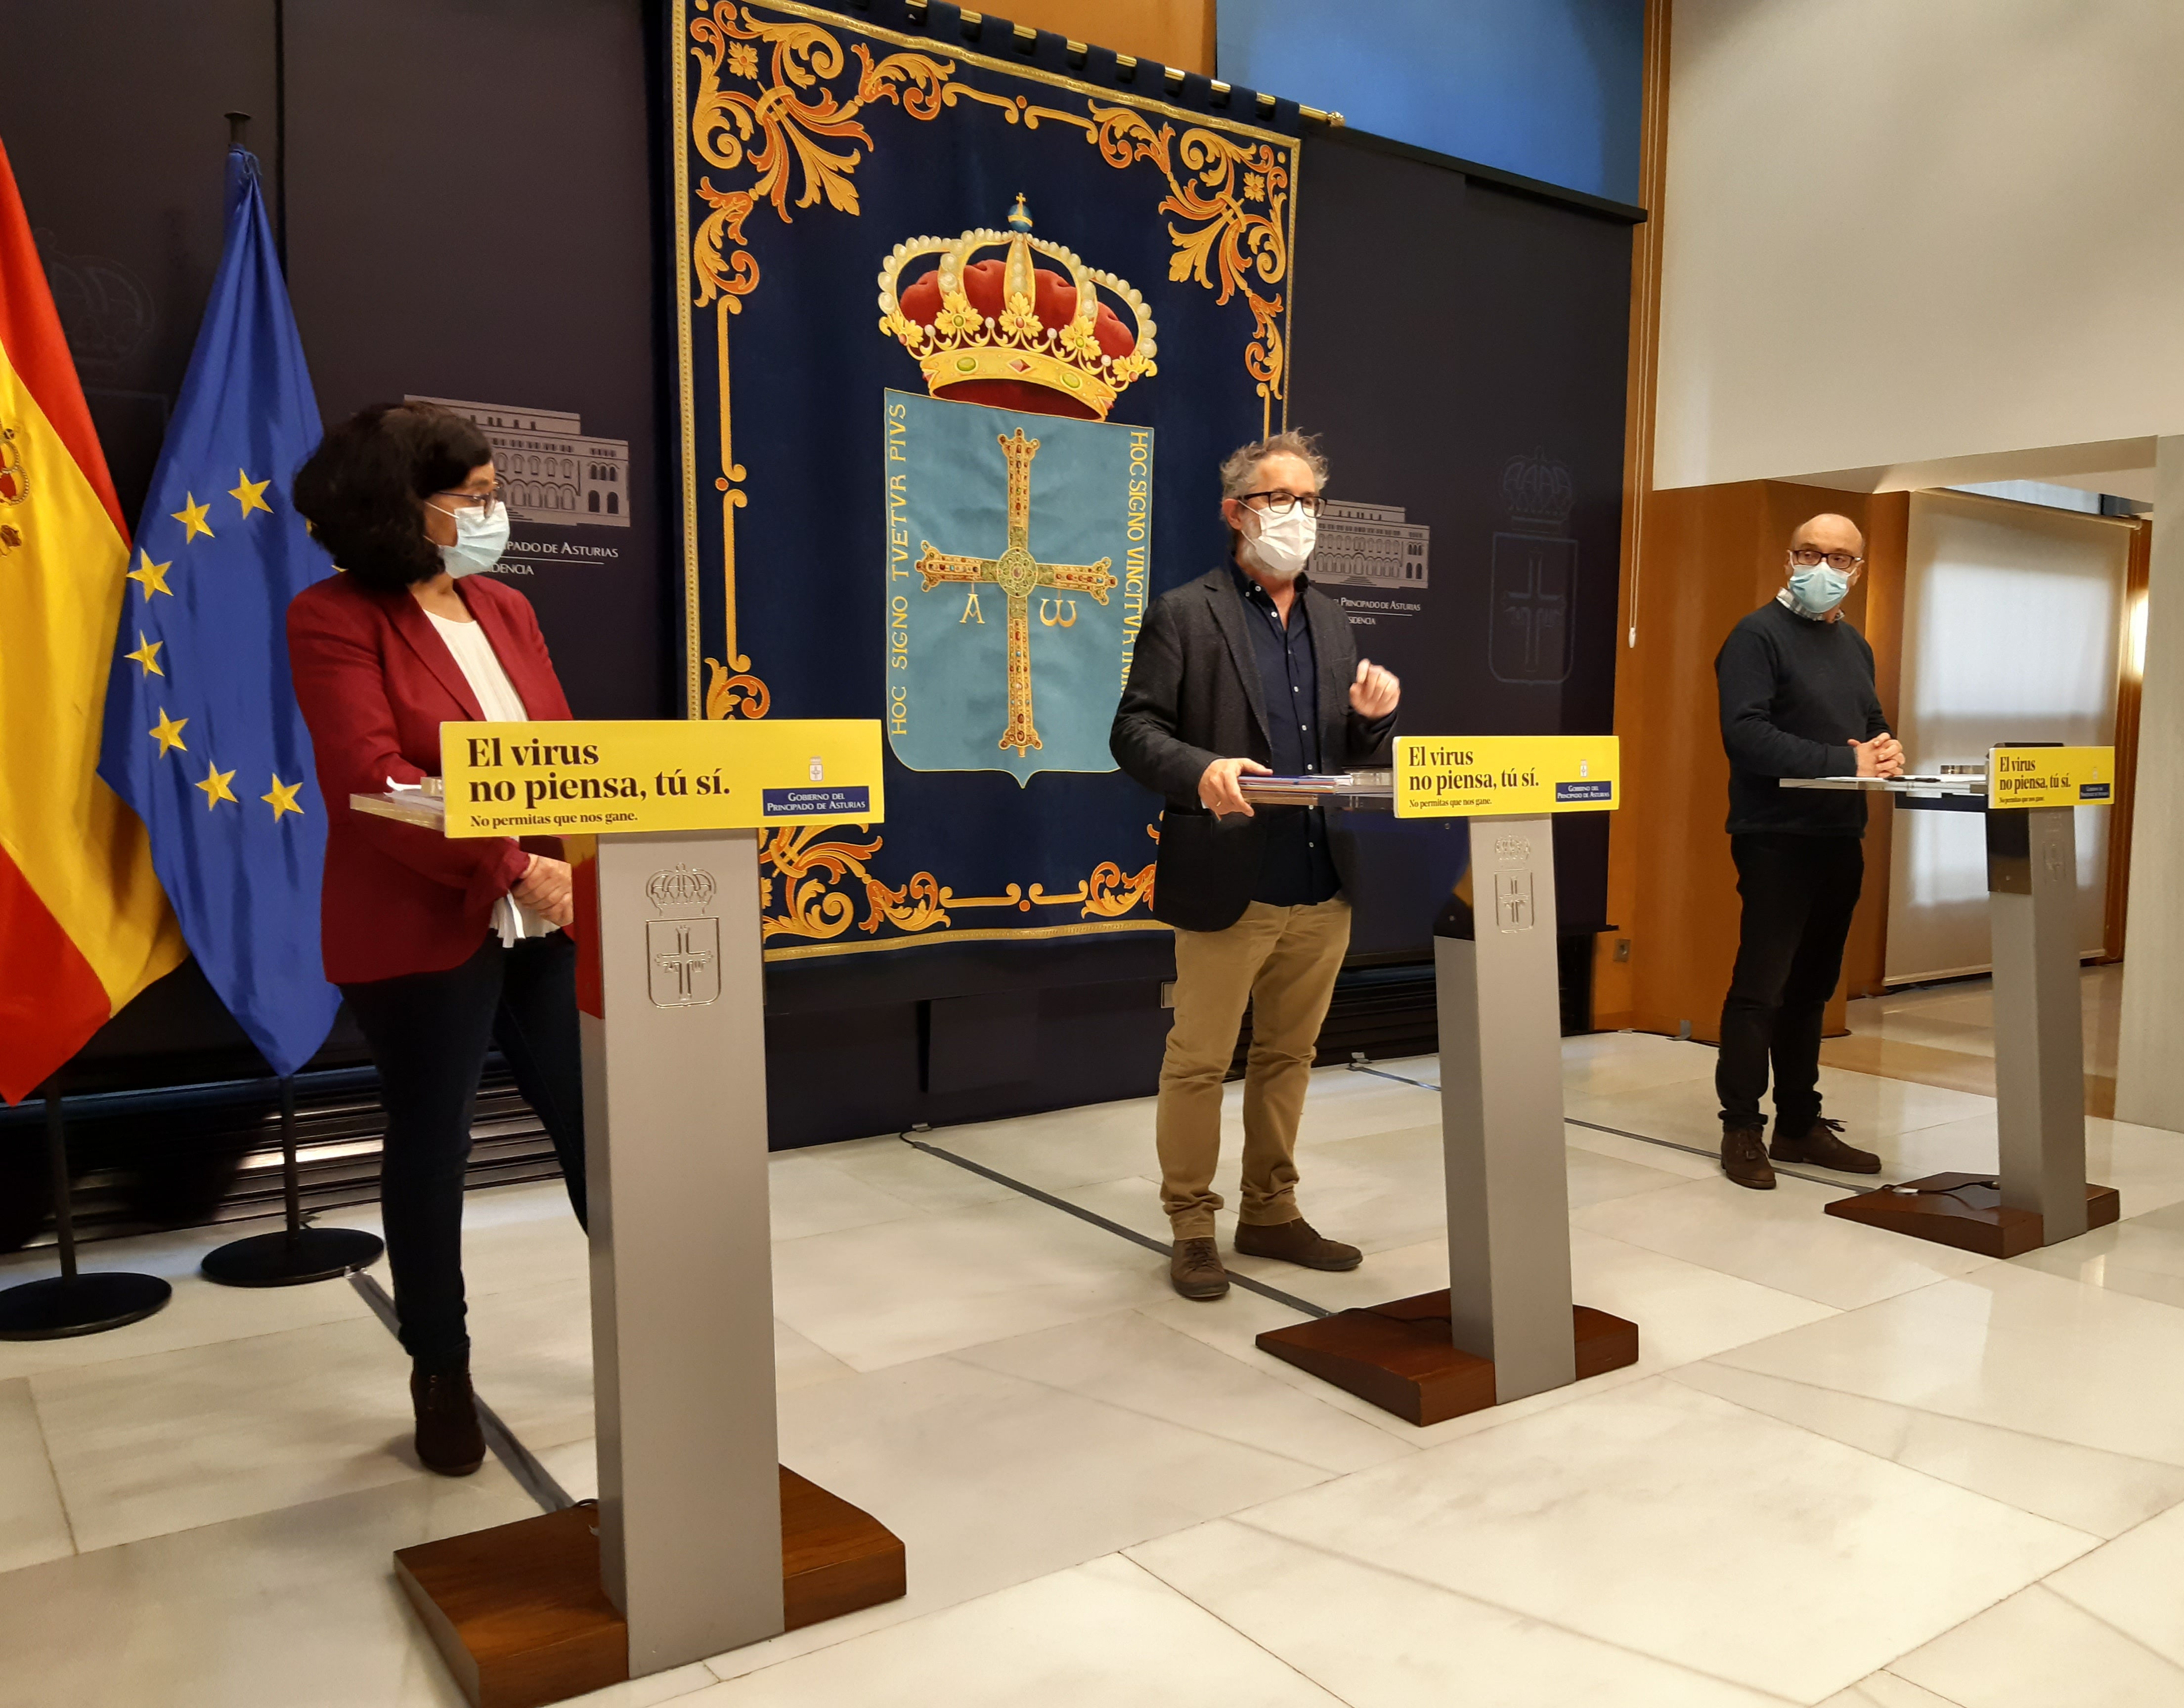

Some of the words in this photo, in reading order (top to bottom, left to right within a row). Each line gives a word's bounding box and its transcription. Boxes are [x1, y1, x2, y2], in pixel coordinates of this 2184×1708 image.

[889, 403, 907, 462] PIVS
[1129, 431, 1148, 477] HOC
[1127, 478, 1147, 542] SIGNO
[890, 474, 910, 582] TVETVR
[542, 543, 559, 554] DE
[560, 542, 619, 557] ASTURIAS
[1390, 600, 1421, 611] ASTURIAS
[891, 596, 909, 670] SIGNO
[891, 686, 907, 735] HOC
[466, 737, 503, 767] El
[511, 738, 599, 766] virus
[1408, 746, 1426, 767] El
[1430, 746, 1473, 766] virus
[2000, 756, 2009, 772] El
[2011, 757, 2036, 771] virus
[469, 780, 516, 802] no
[524, 771, 647, 809] piensa,
[654, 769, 688, 796] tú
[696, 768, 730, 795] sí.
[1409, 775, 1432, 791] no
[1436, 769, 1497, 796] piensa,
[1501, 768, 1518, 787] tú
[1522, 767, 1539, 787] sí.
[2000, 778, 2012, 790] no
[2014, 774, 2048, 794] piensa,
[2050, 773, 2059, 788] tú
[767, 803, 814, 811] PRINCIPADO
[829, 801, 866, 809] ASTURIAS
[787, 792, 830, 802] GOBIERNO
[1409, 799, 1419, 808] No
[1420, 799, 1449, 809] permitas
[1449, 799, 1462, 808] que
[470, 815, 490, 827] No
[492, 814, 551, 829] permitas
[553, 814, 577, 827] que
[580, 813, 603, 822] nos
[605, 812, 638, 825] gane.
